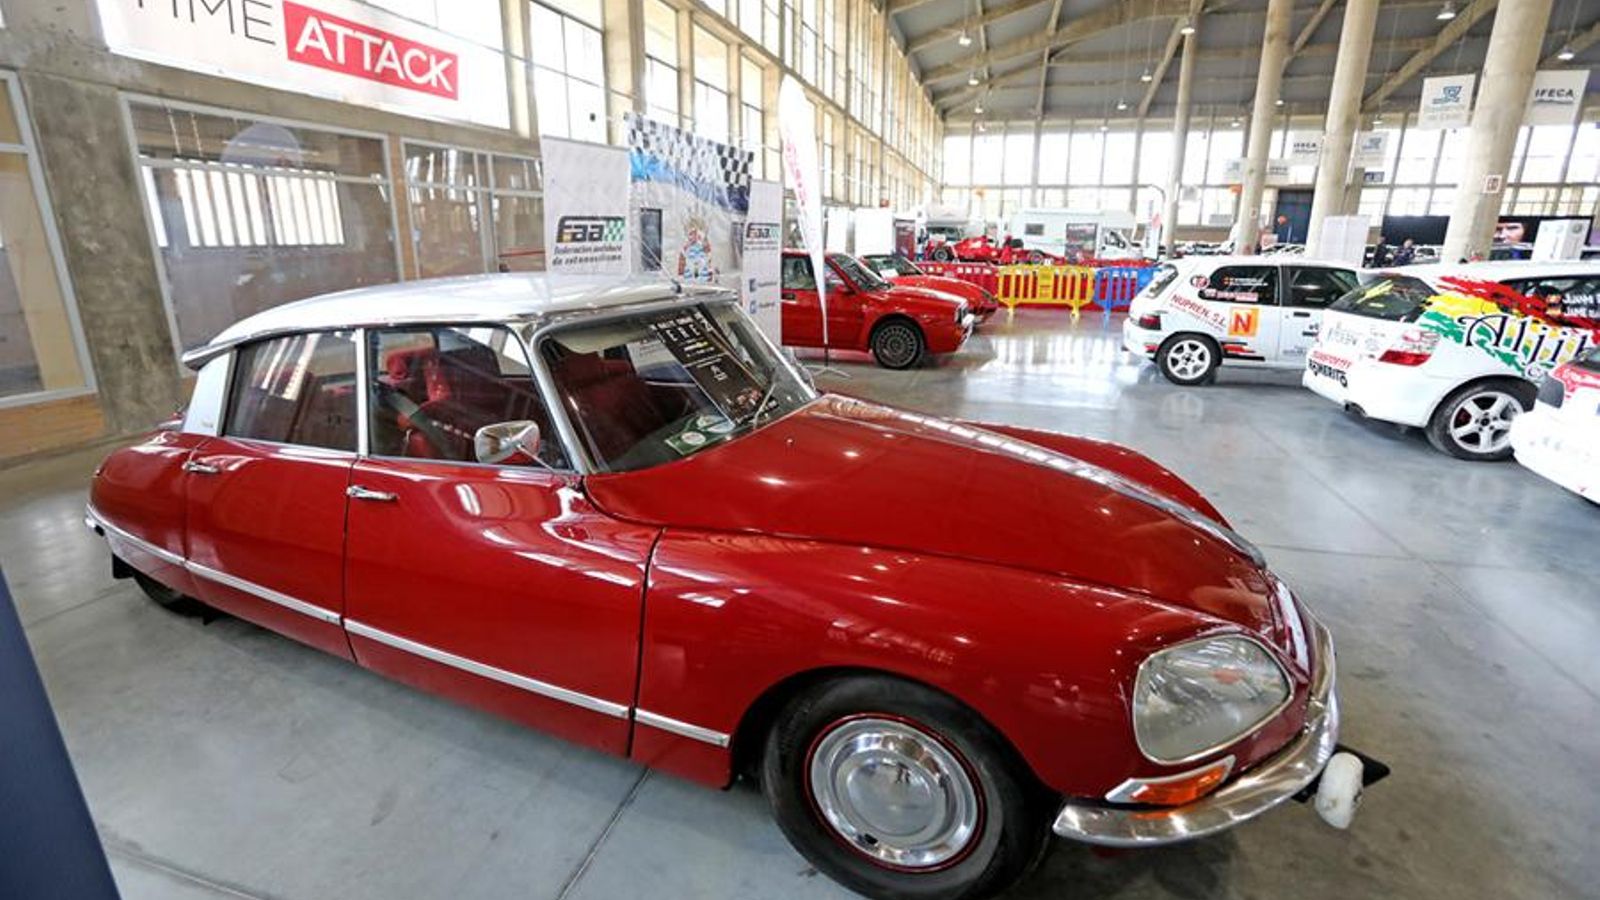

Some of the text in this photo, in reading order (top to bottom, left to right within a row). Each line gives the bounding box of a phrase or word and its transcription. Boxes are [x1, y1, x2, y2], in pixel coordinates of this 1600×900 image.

[137, 0, 453, 92] ME ATTACK
[1534, 88, 1575, 98] IFECA
[1233, 312, 1252, 332] N
